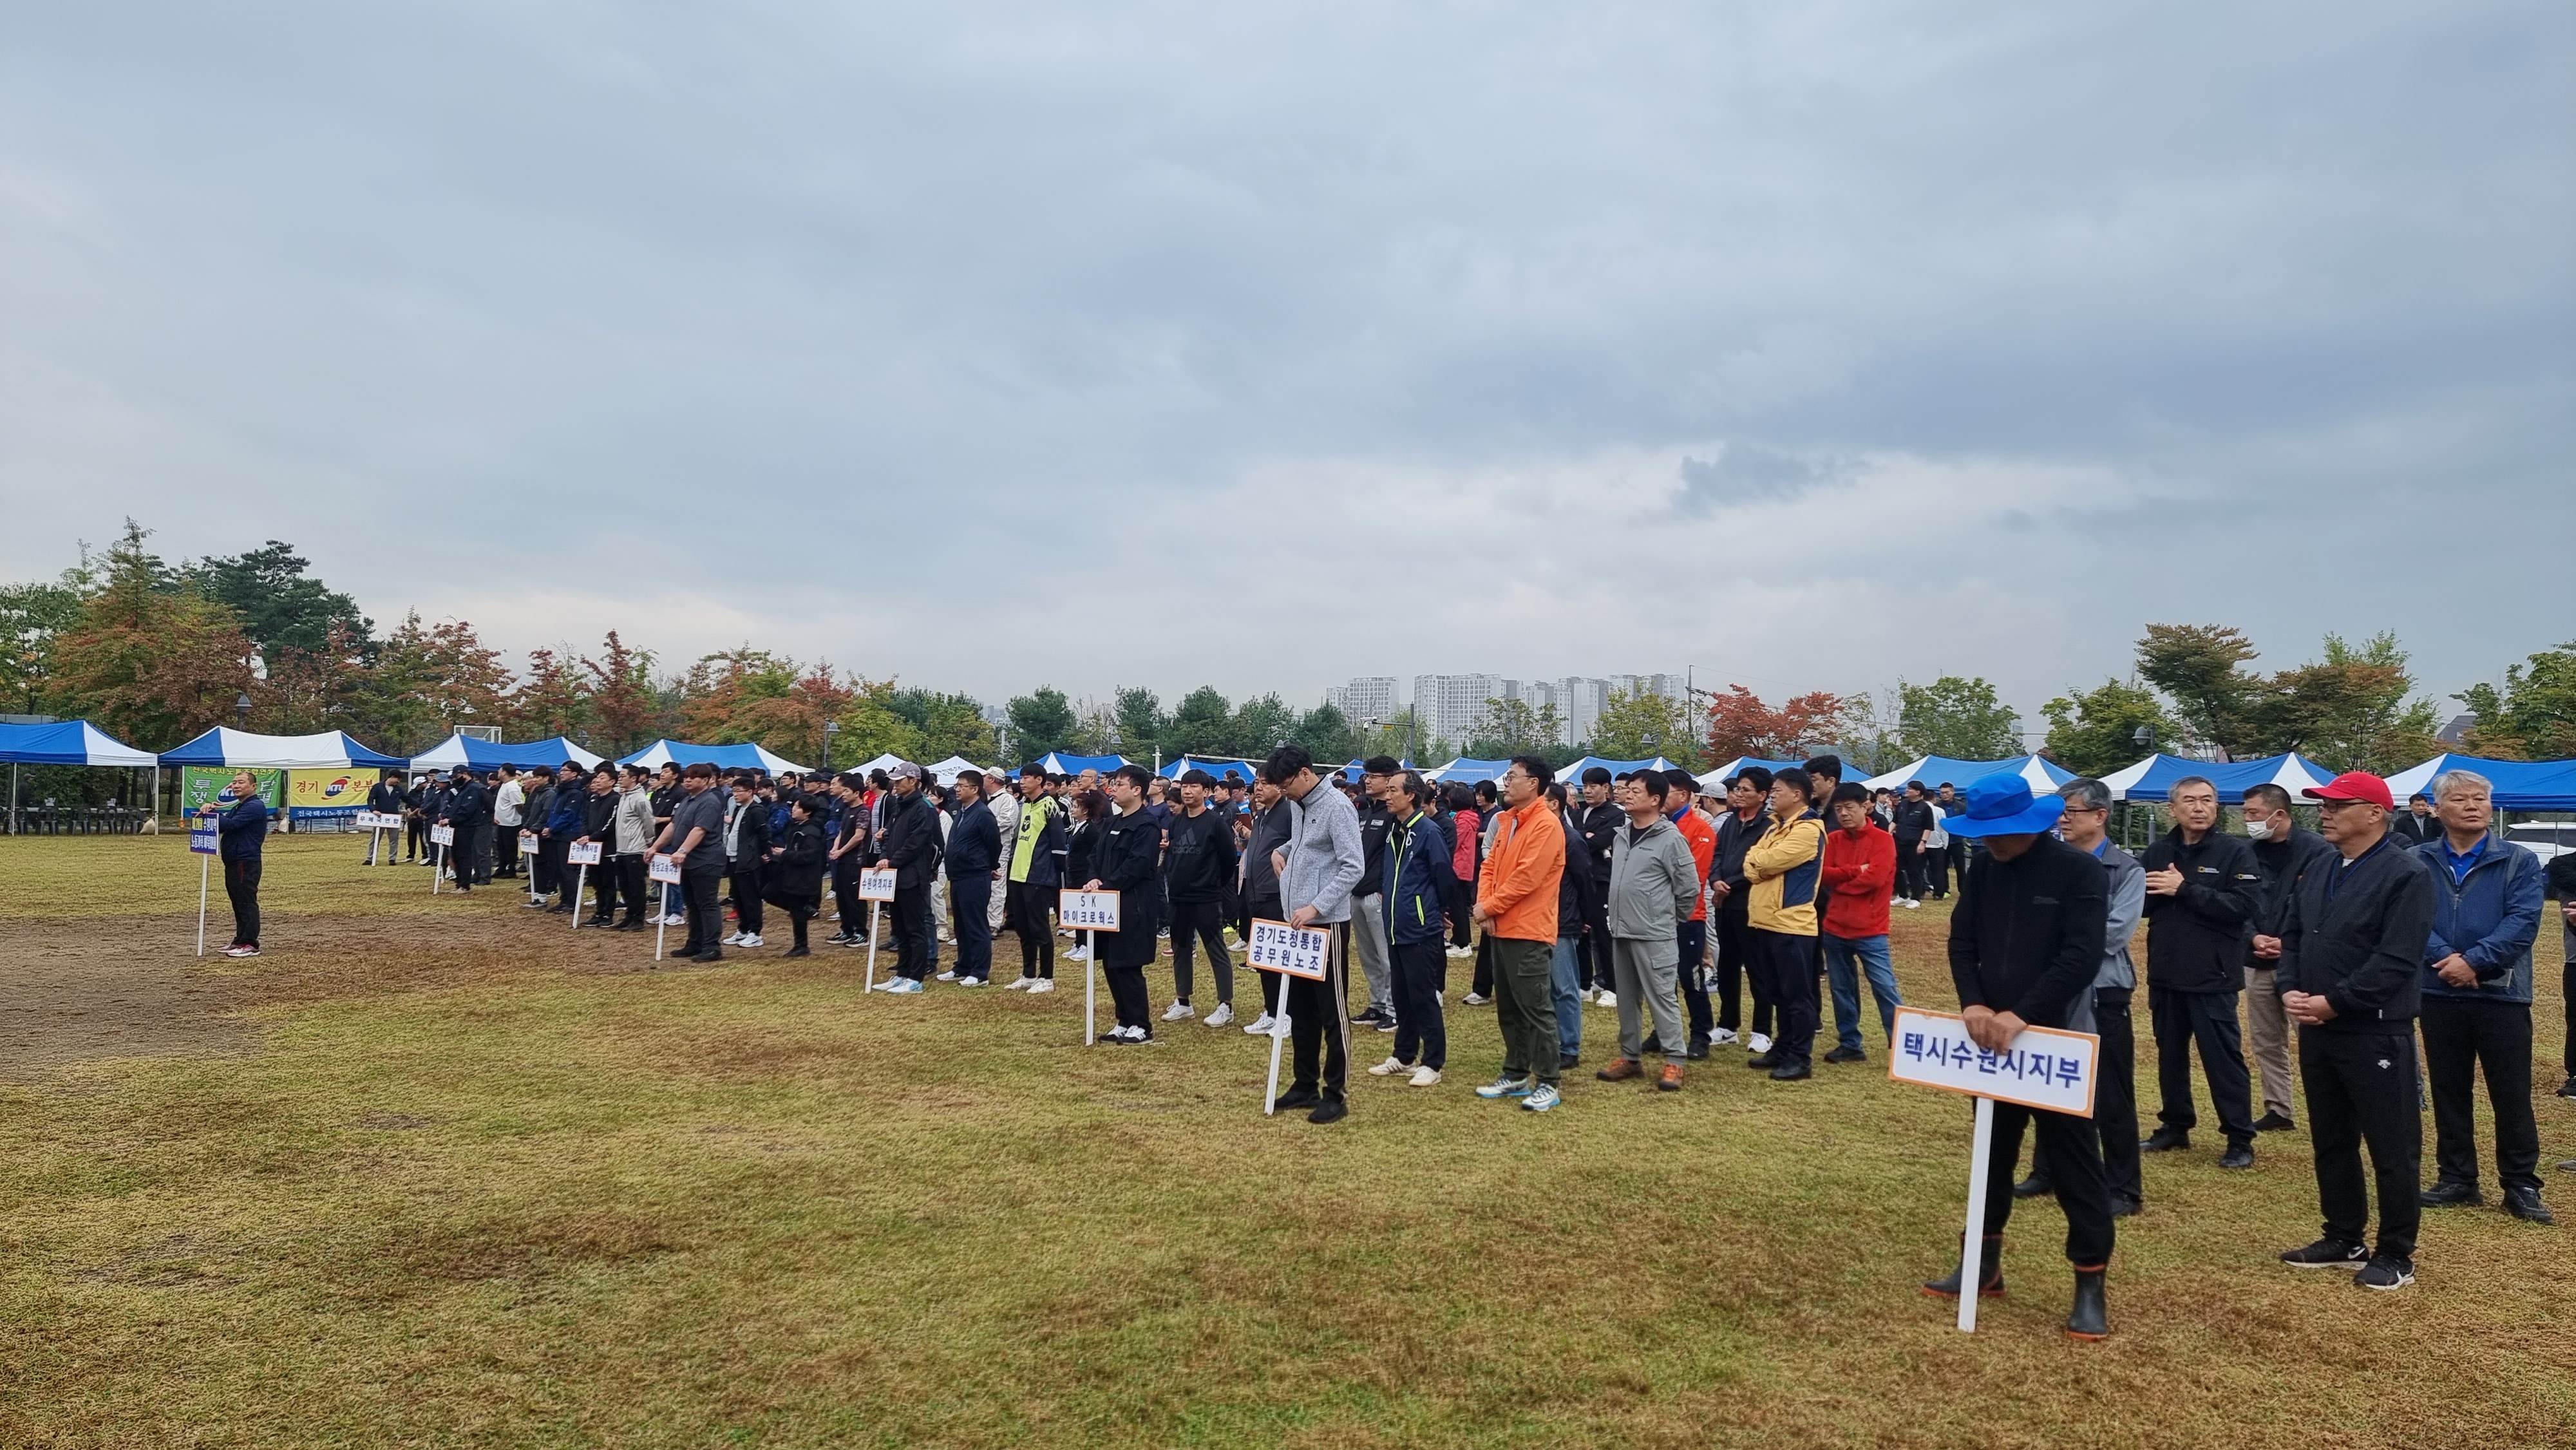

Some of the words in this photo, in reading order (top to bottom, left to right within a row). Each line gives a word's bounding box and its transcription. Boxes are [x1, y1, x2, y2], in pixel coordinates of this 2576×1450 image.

[296, 780, 319, 794] 경기
[327, 784, 347, 792] KTU
[352, 779, 374, 793] 본부
[359, 816, 399, 824] 우체국연합
[862, 878, 893, 891] 수원여객지부
[1064, 909, 1114, 925] 마이크로웍스
[1256, 926, 1322, 952] 경기도청통합
[1253, 945, 1319, 971] 공무원노조
[1904, 1032, 2081, 1089] 택시수원시지부
